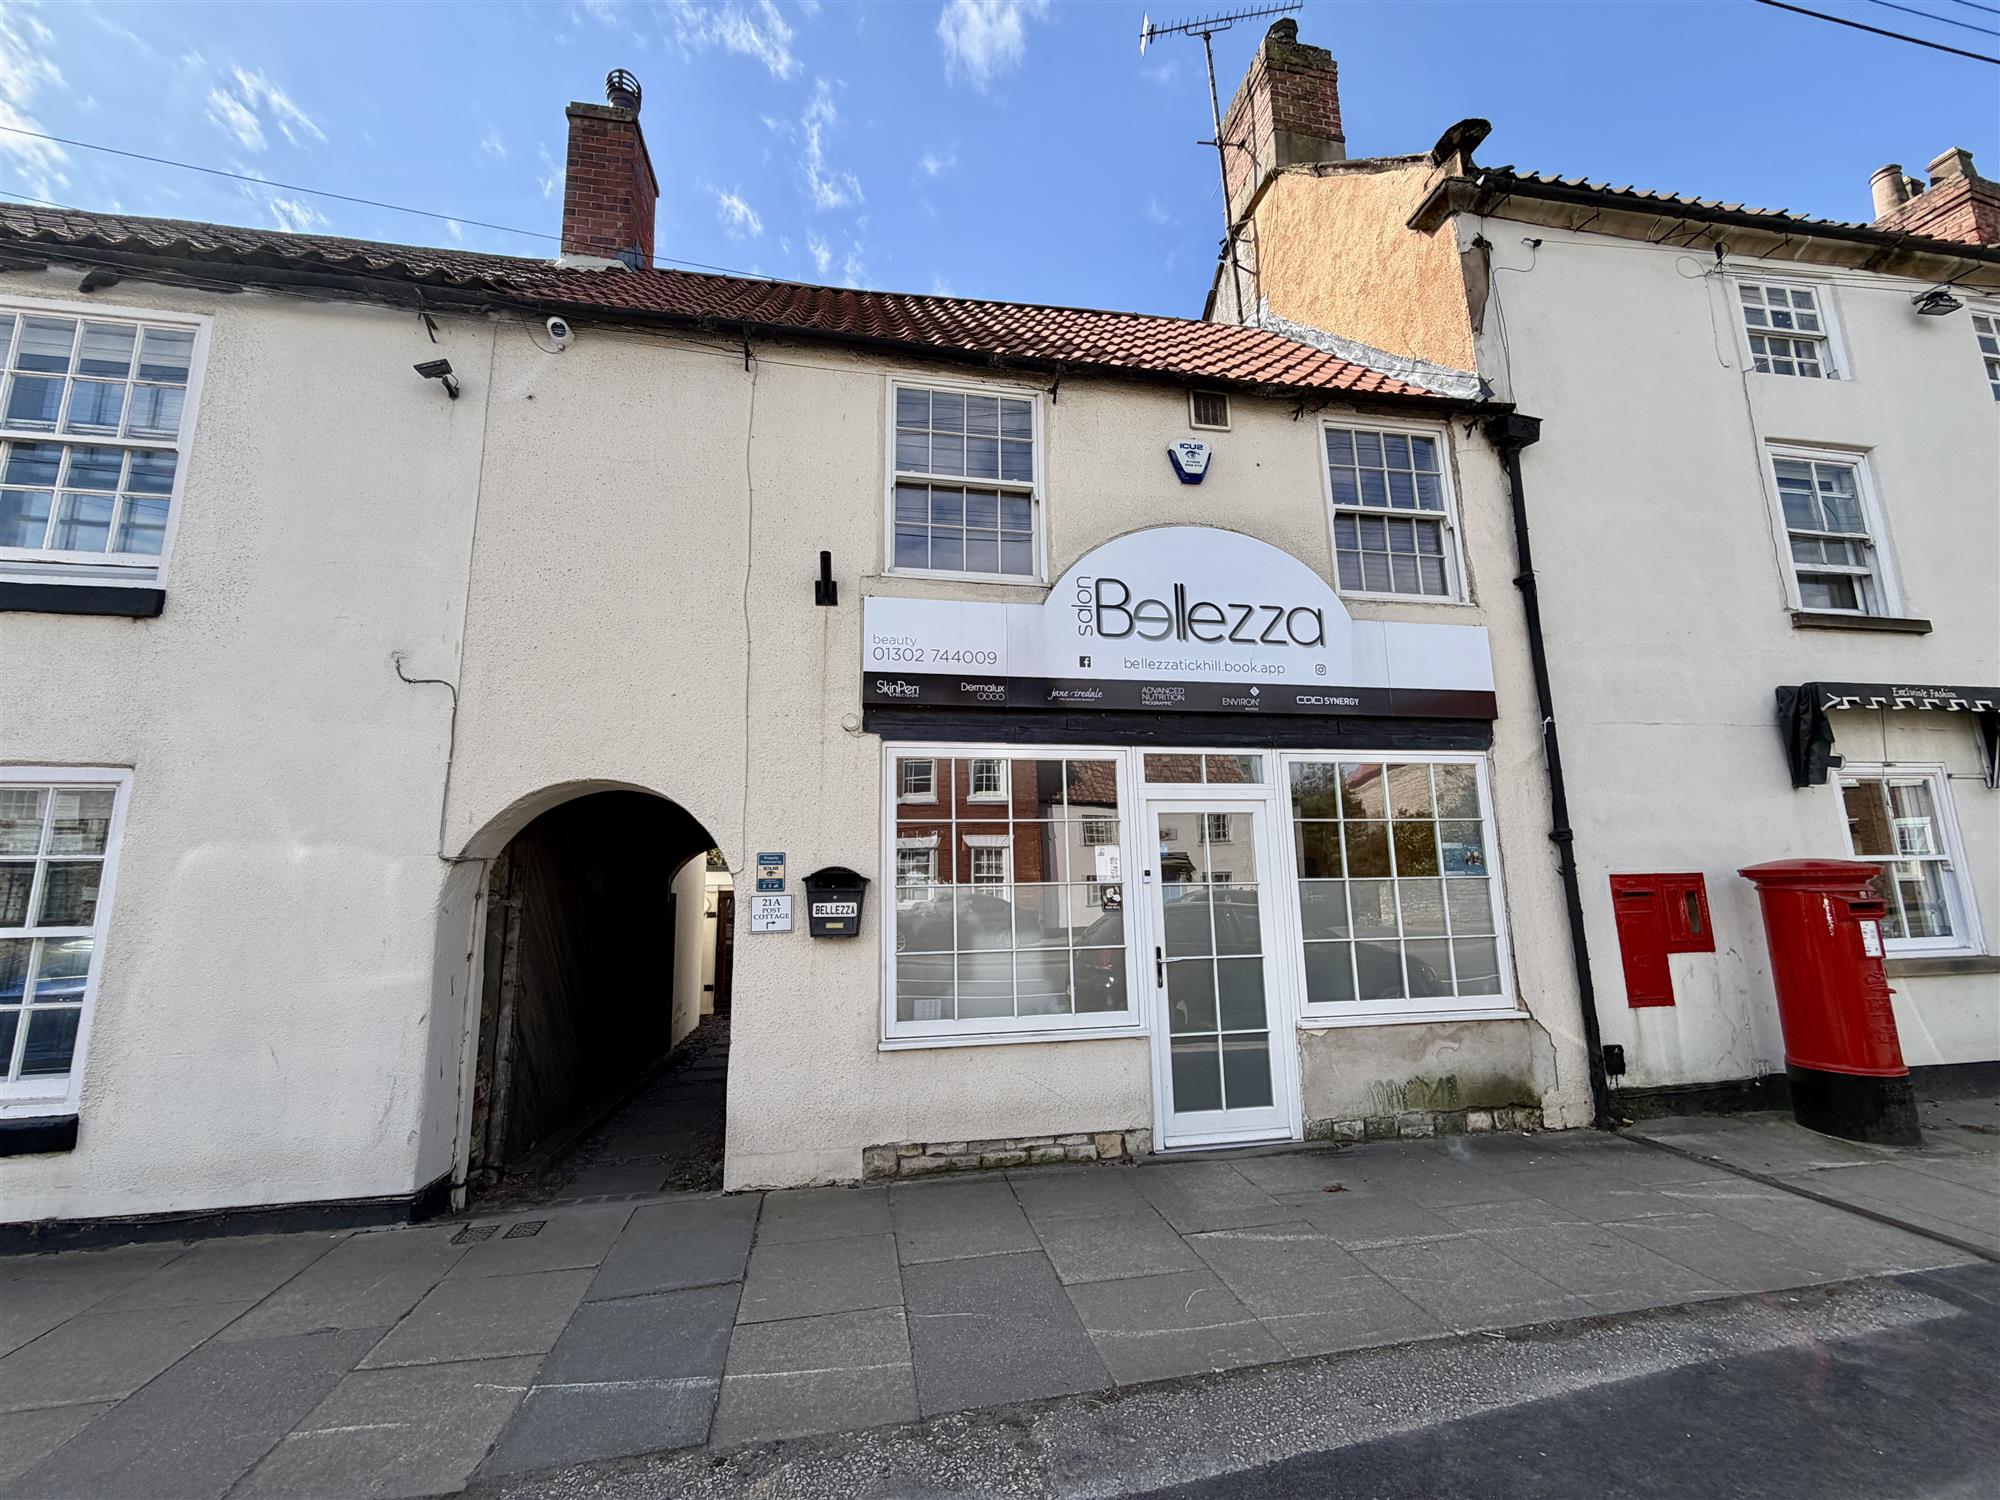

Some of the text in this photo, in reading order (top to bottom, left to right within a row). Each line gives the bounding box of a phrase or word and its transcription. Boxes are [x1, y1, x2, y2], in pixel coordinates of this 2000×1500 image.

[1179, 443, 1204, 451] ICU2
[1071, 576, 1093, 636] salon
[1095, 577, 1327, 648] Bellezza
[872, 634, 918, 647] beauty
[872, 646, 998, 665] 01302 744009
[1123, 657, 1286, 676] bellezzatickhill.book.app
[876, 680, 920, 698] SkinPen
[961, 682, 1005, 693] Dermalux
[1047, 687, 1069, 700] jane
[1142, 687, 1185, 695] ADVANCED
[1222, 697, 1260, 707] ENVIRON
[1324, 697, 1360, 706] SYNERGY
[762, 898, 781, 907] 21A
[815, 905, 855, 915] BELLEZZA
